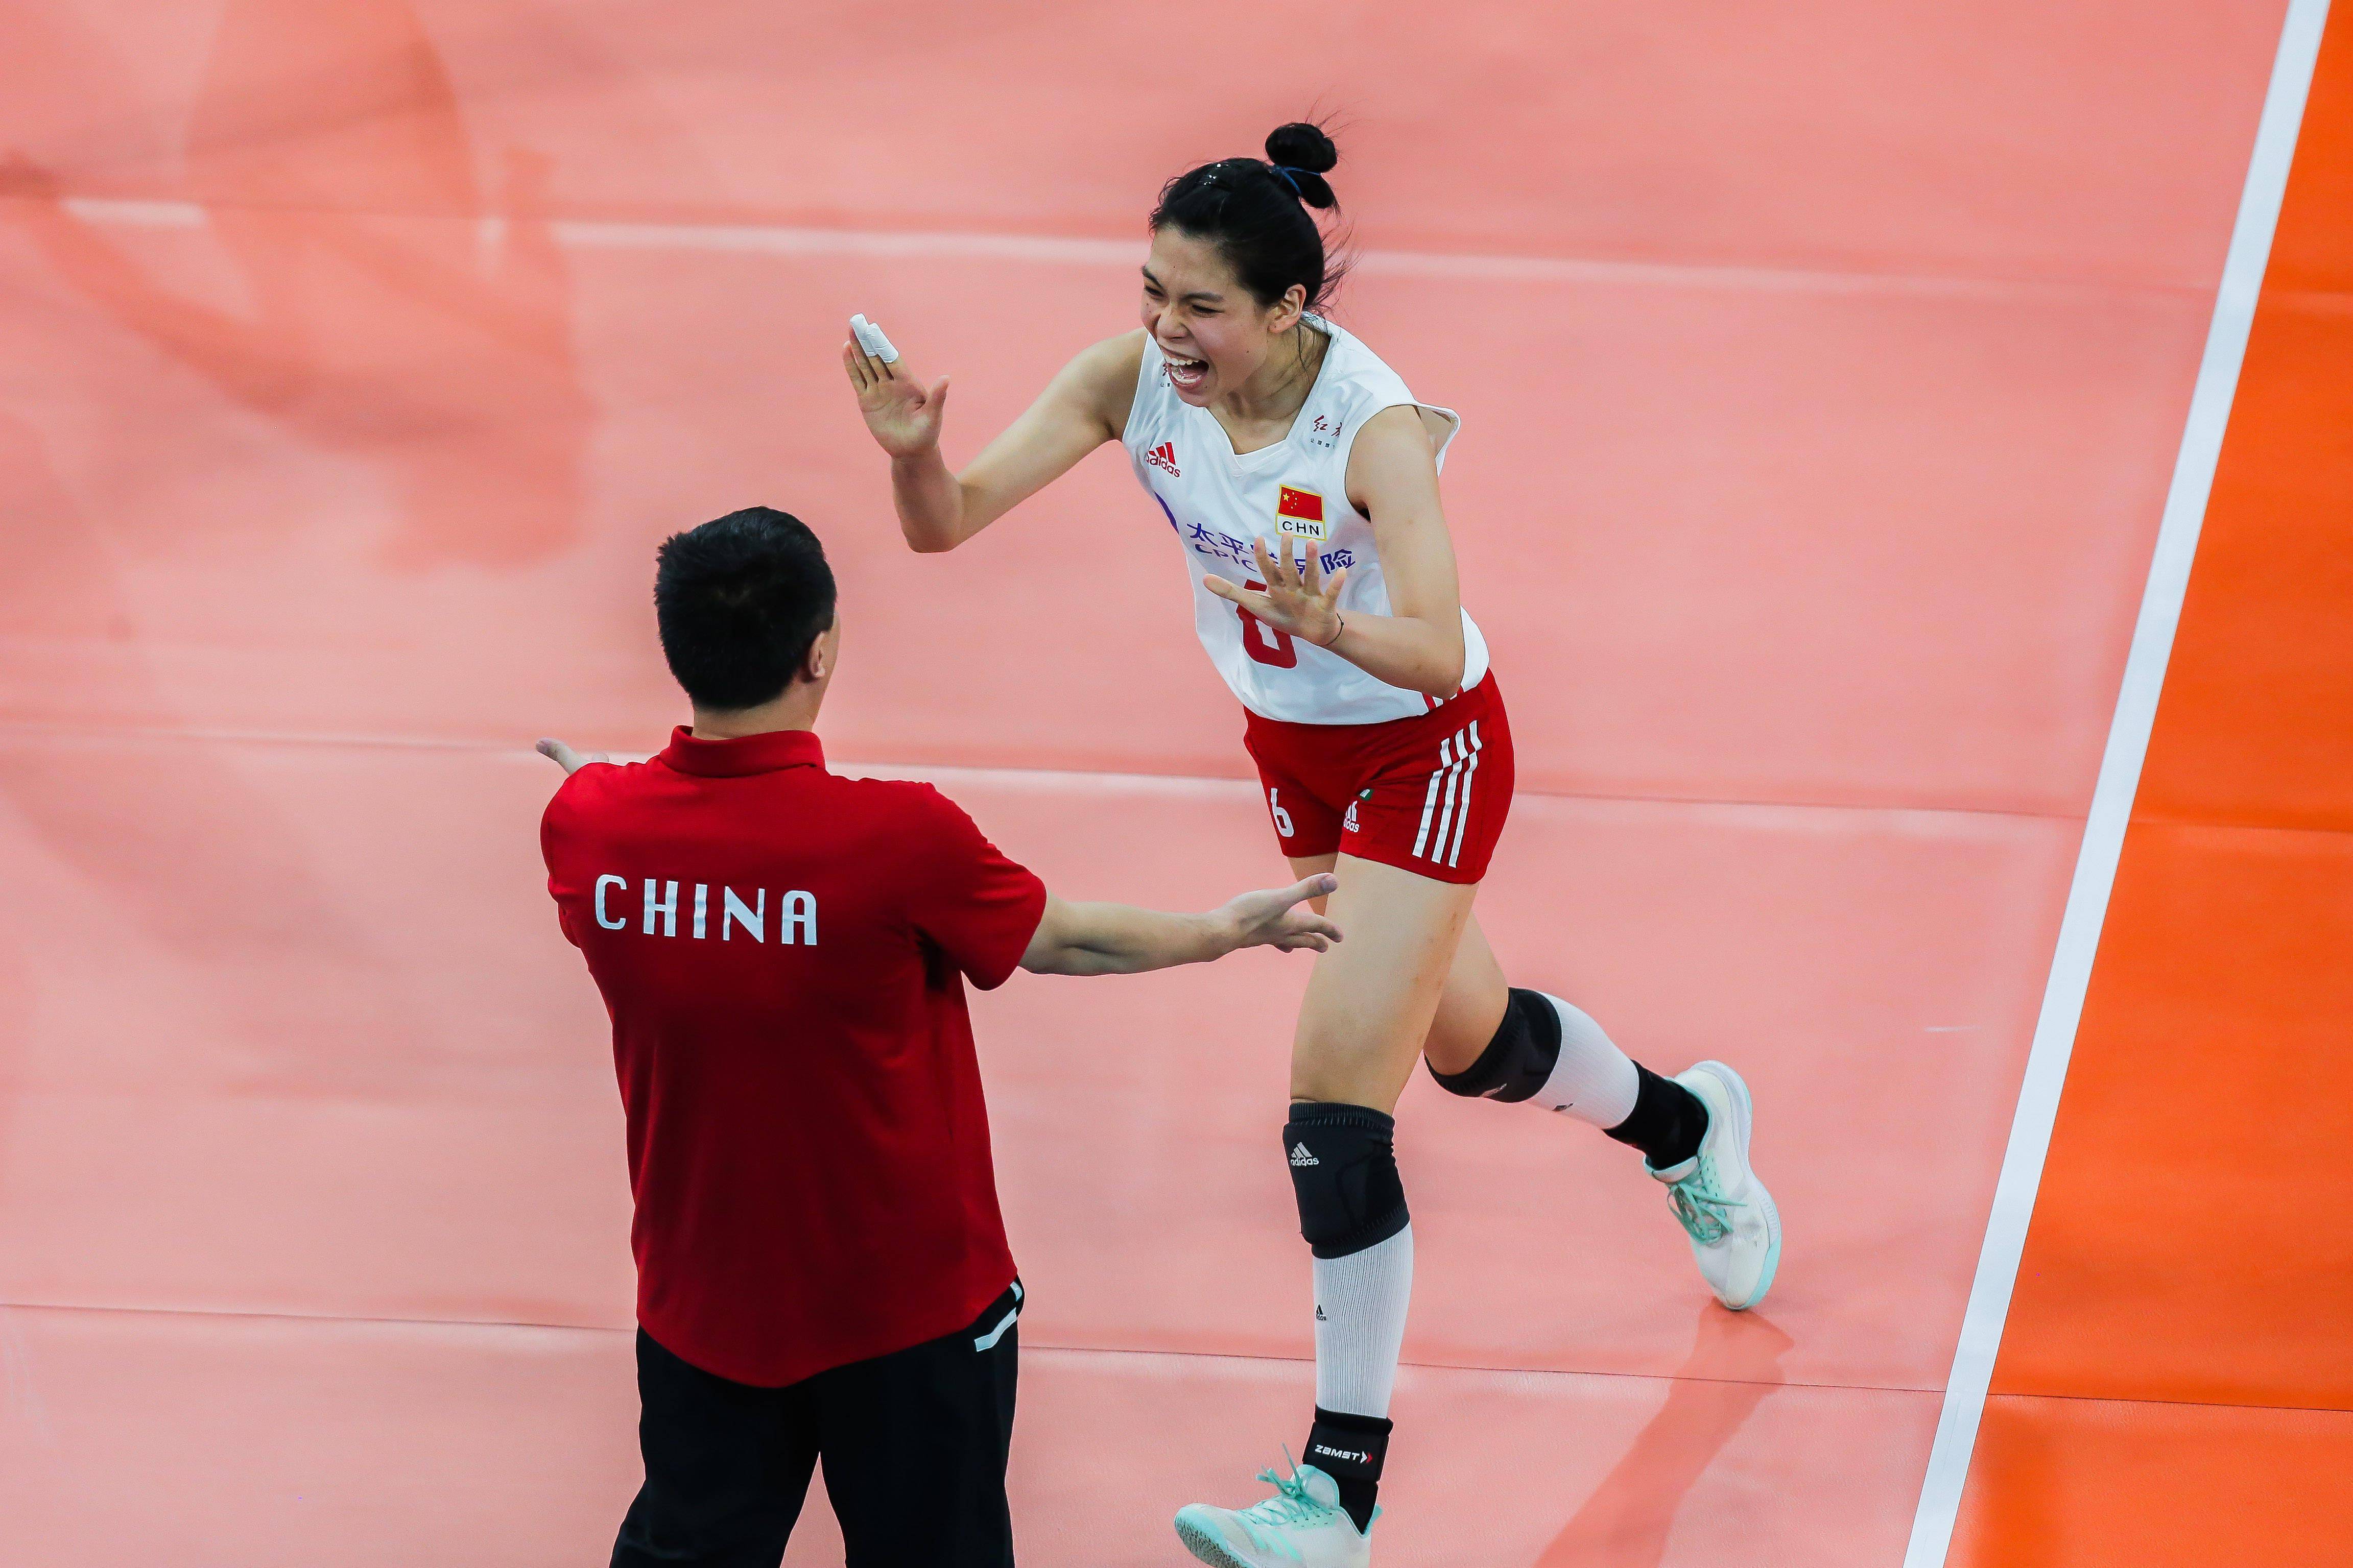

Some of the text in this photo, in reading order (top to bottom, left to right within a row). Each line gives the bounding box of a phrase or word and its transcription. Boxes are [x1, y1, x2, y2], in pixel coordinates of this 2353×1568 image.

[1282, 521, 1319, 536] CHN
[1186, 522, 1357, 575] 太平险
[1195, 543, 1257, 572] CPIC
[1271, 787, 1294, 837] 6
[595, 874, 817, 946] CHINA
[1290, 1156, 1319, 1167] adidas
